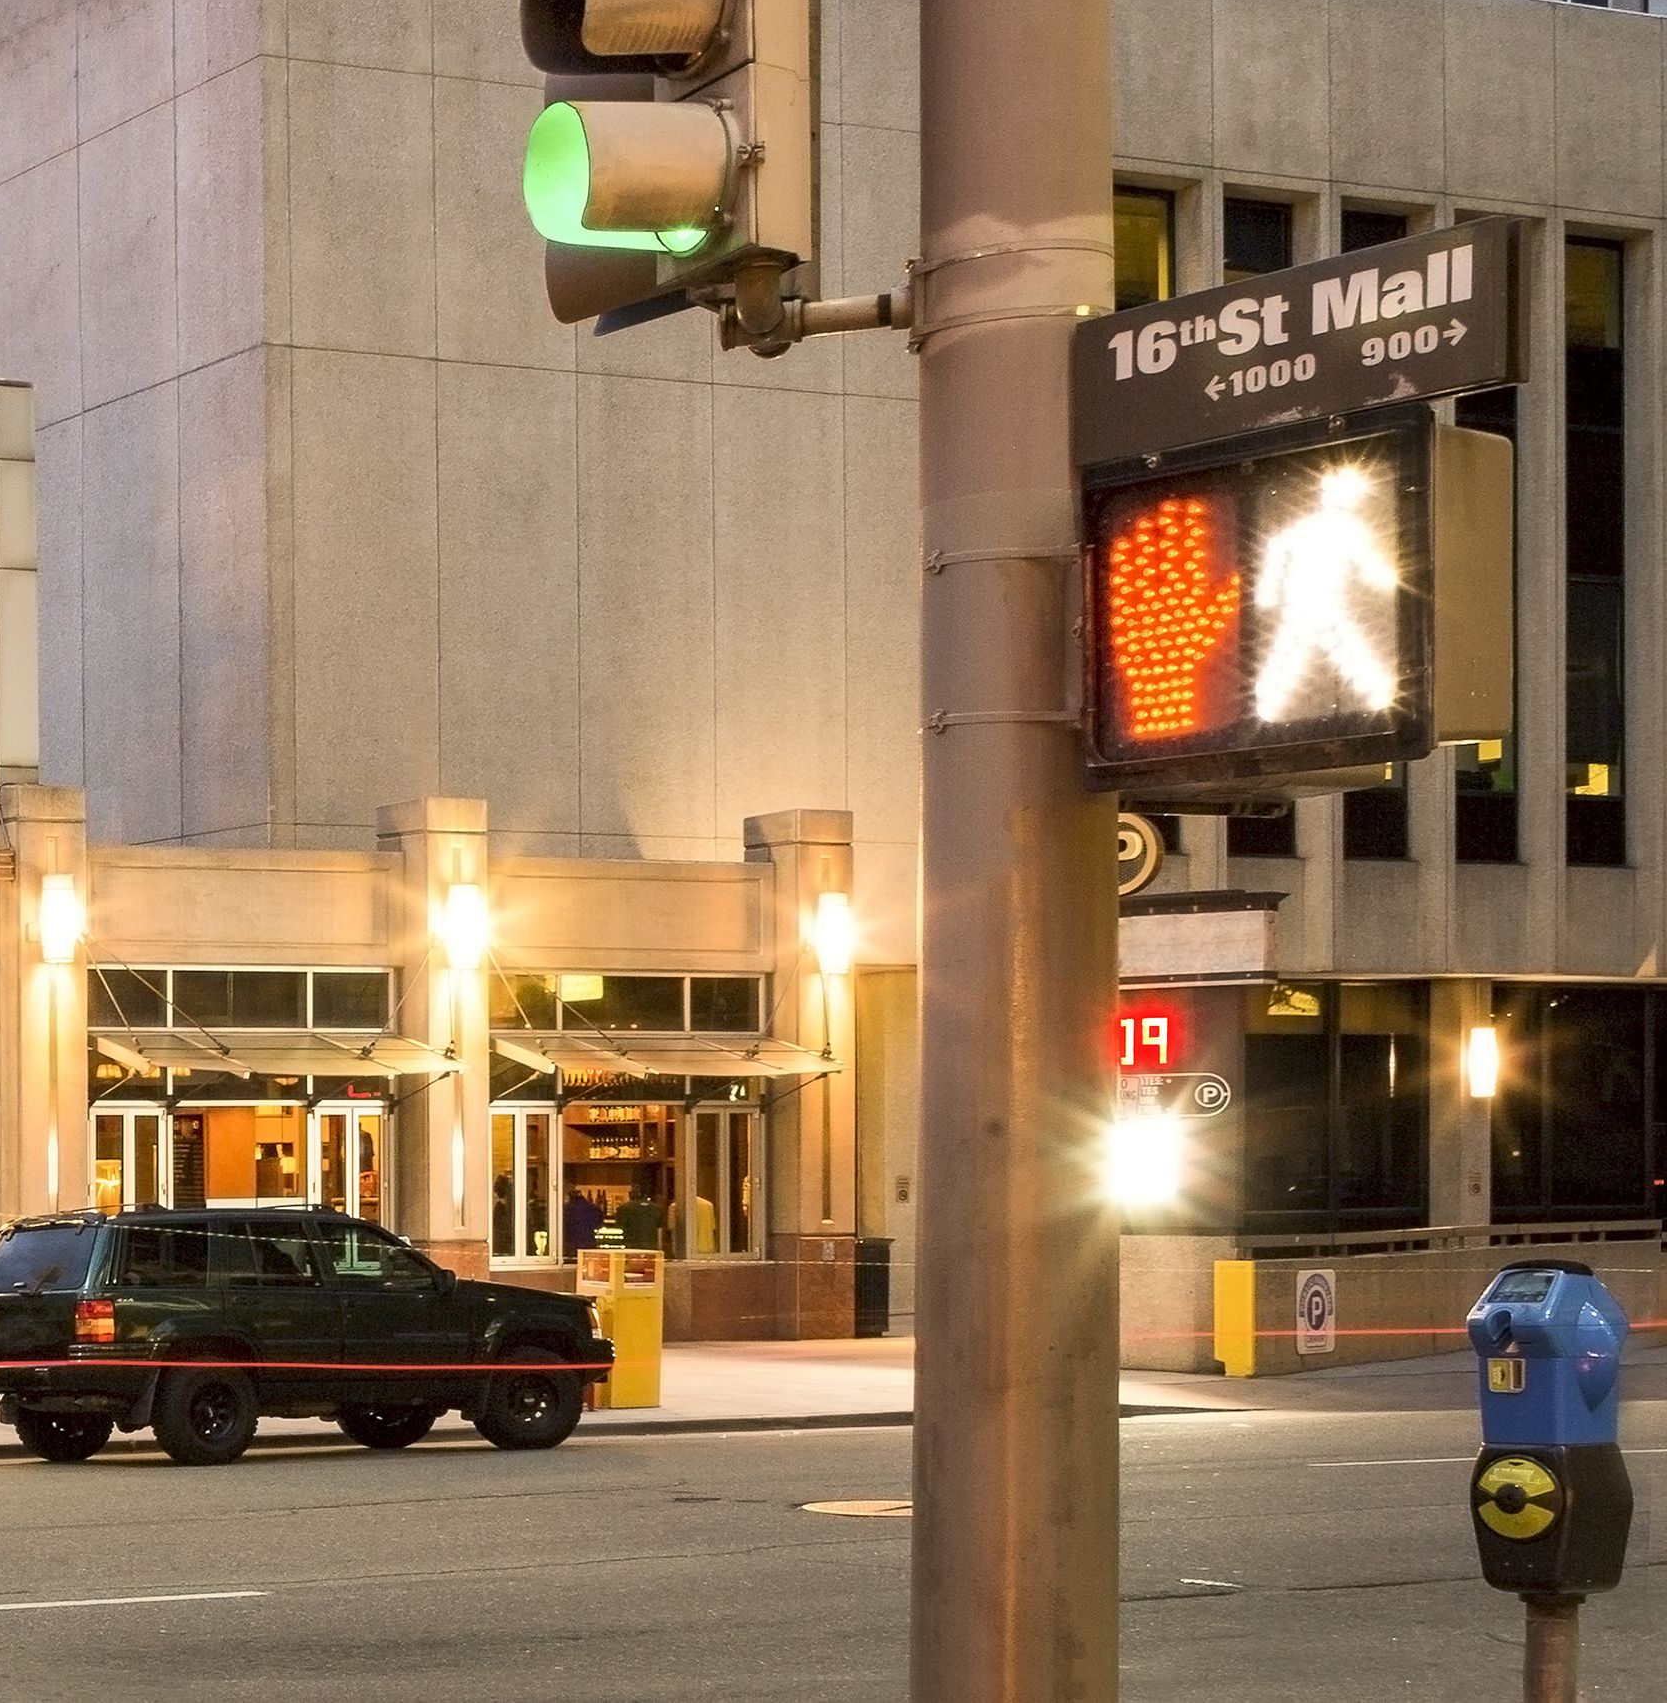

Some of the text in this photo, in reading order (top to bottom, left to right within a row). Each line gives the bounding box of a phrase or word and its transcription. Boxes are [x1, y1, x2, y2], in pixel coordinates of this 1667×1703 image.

[1311, 244, 1473, 335] Mall
[1229, 325, 1439, 396] 1000 900
